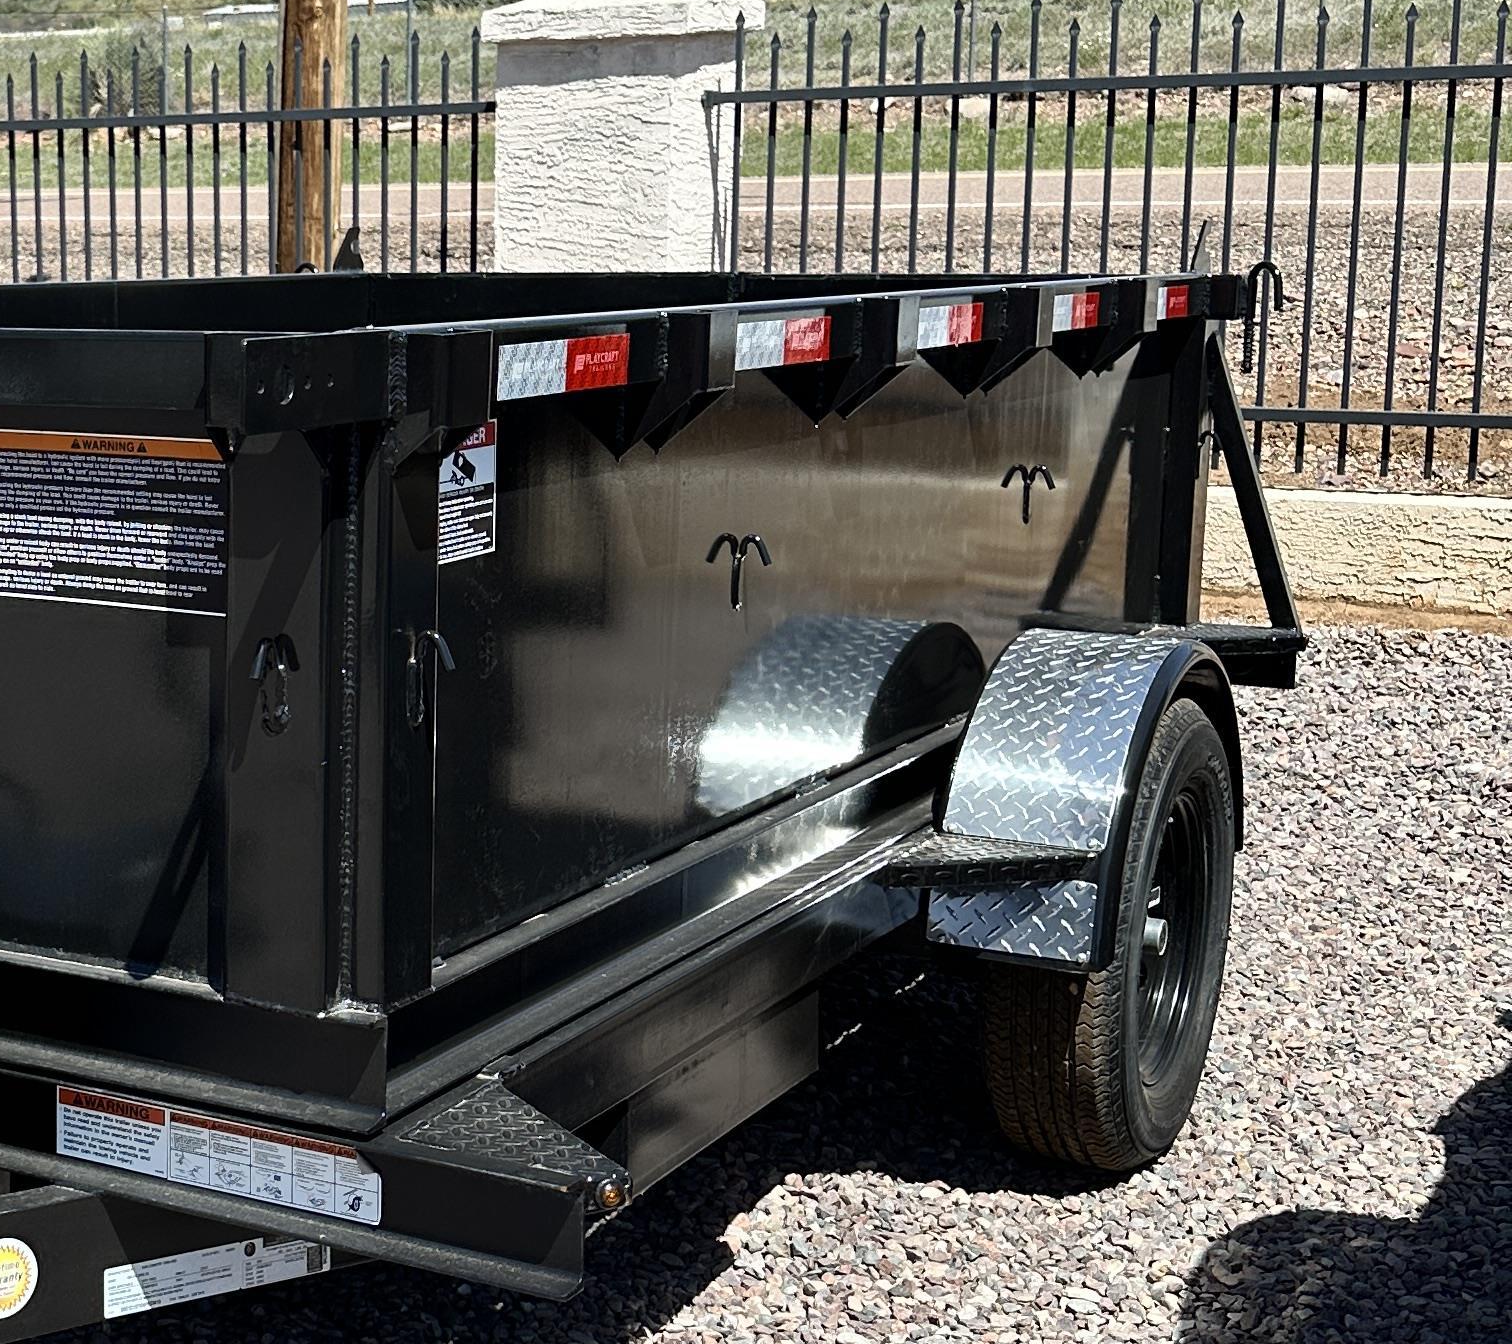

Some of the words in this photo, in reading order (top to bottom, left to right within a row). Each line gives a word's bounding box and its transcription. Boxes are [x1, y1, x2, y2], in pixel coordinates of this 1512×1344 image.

[585, 350, 620, 365] PLAYCRAFT
[82, 438, 134, 453] WARNING
[83, 1094, 151, 1119] WARNING
